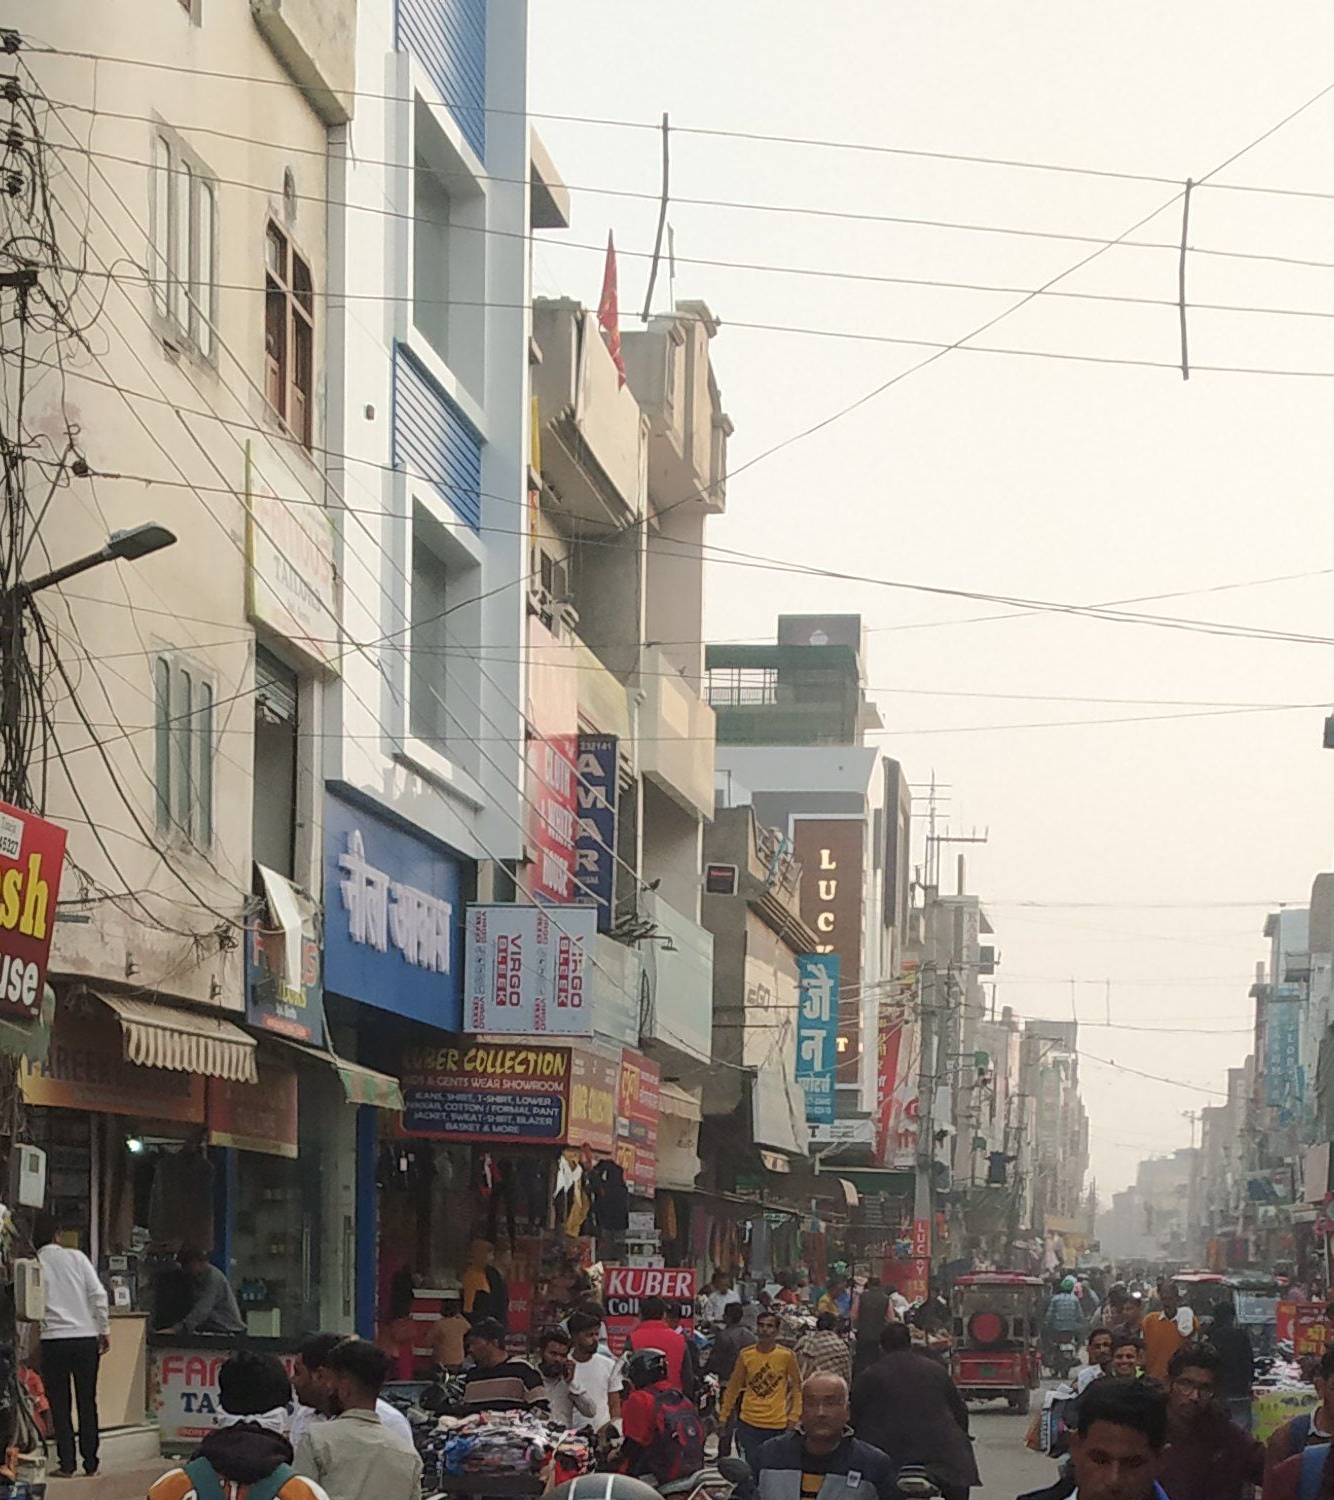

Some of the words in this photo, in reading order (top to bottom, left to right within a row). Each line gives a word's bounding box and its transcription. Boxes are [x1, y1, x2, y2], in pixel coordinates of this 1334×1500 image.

[816, 849, 836, 954] LUC
[510, 934, 522, 1006] VIRGO
[464, 1048, 567, 1077] COLLECTION
[437, 1077, 469, 1088] GENTS
[471, 1079, 501, 1090] WEAR
[502, 1079, 564, 1092] SHOWROOM
[609, 1271, 692, 1297] KUBER
